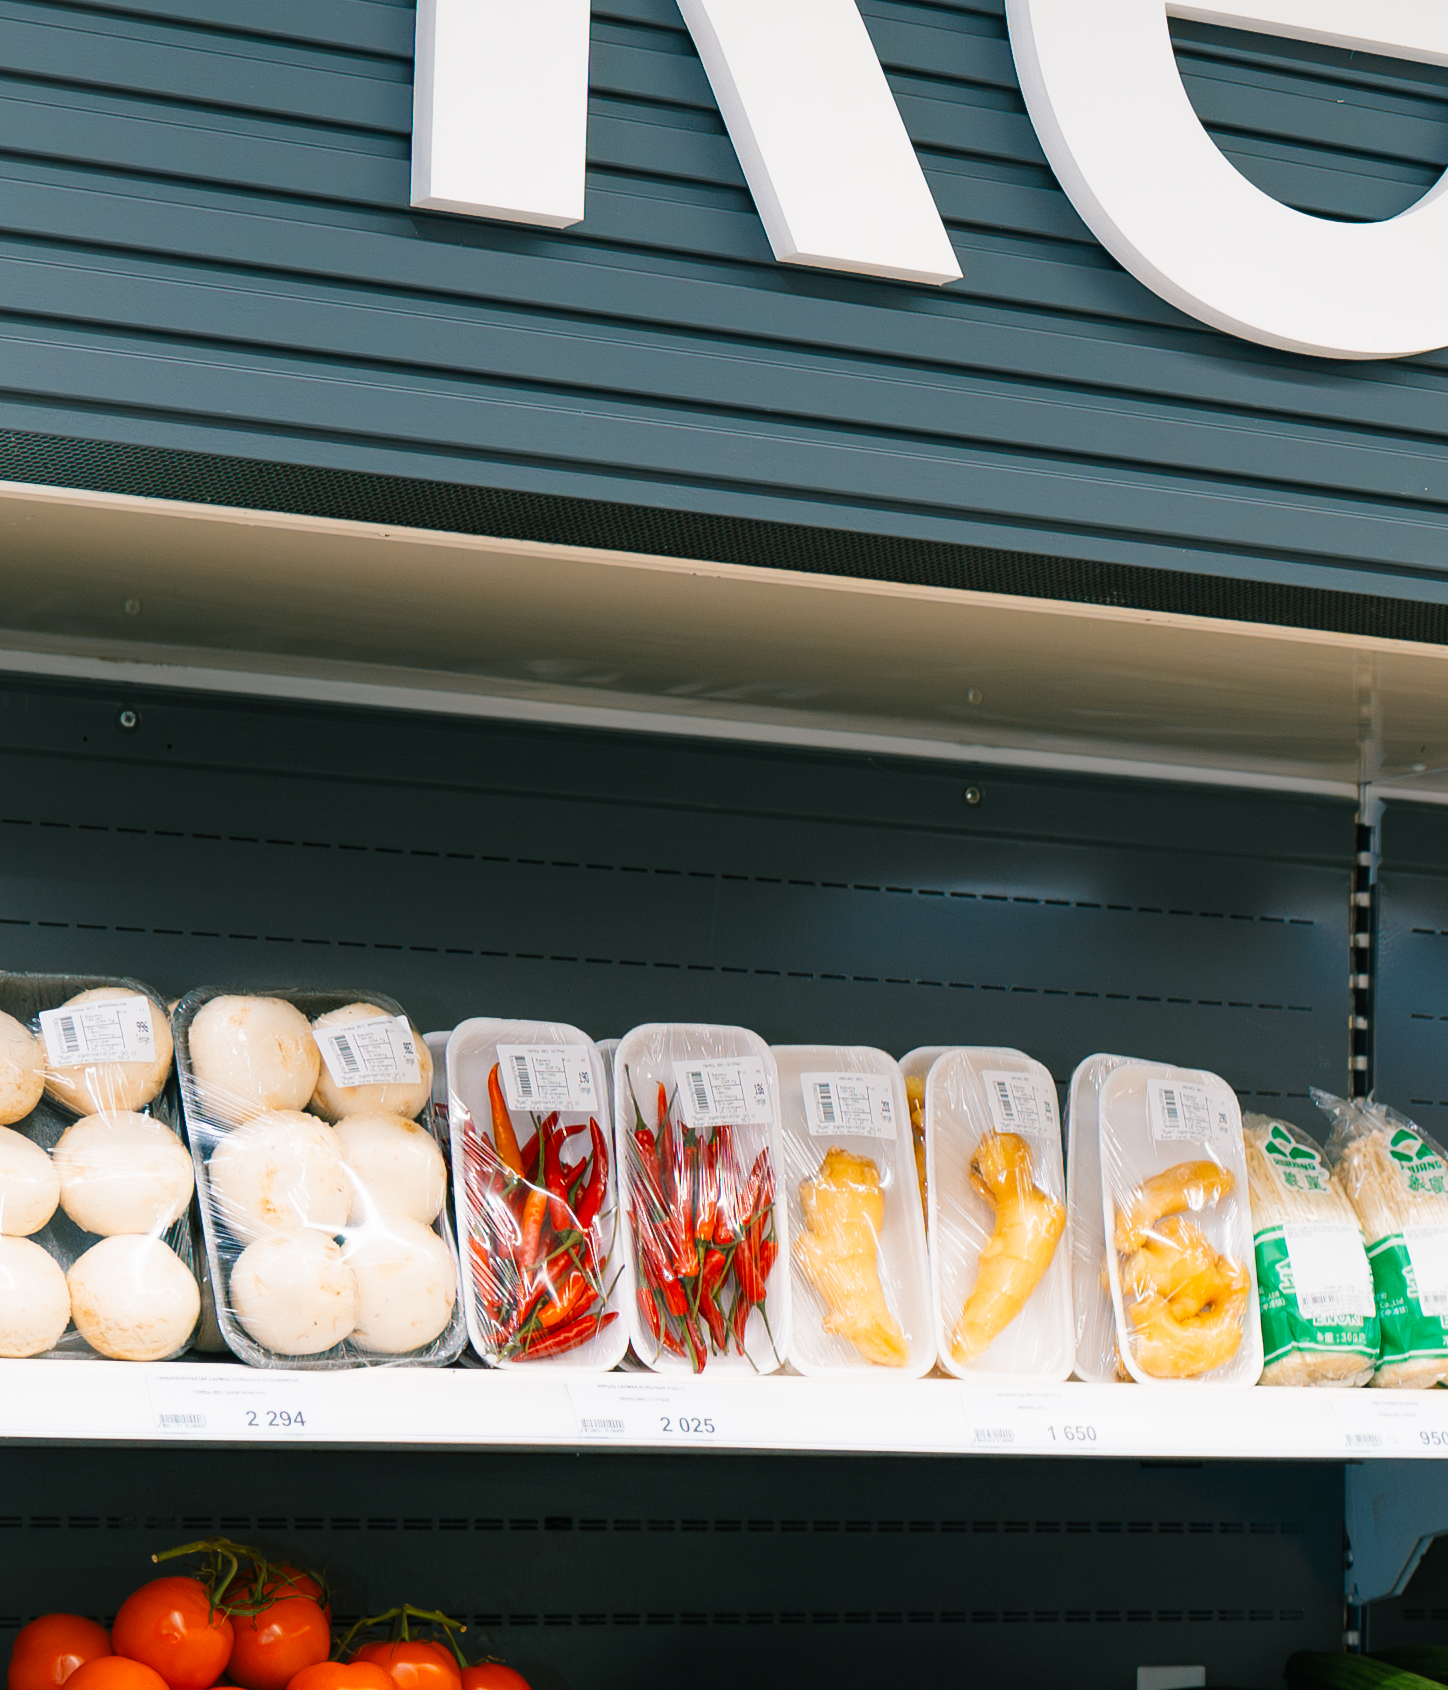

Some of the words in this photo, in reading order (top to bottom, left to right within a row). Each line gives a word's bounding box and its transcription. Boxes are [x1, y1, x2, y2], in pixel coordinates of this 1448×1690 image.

[1315, 1313, 1362, 1326] ENOKI
[246, 1410, 259, 1427] 2
[266, 1410, 306, 1427] 294
[660, 1417, 673, 1432] 2
[679, 1417, 715, 1433] 025
[1047, 1425, 1056, 1441] 1
[1064, 1425, 1097, 1441] 650
